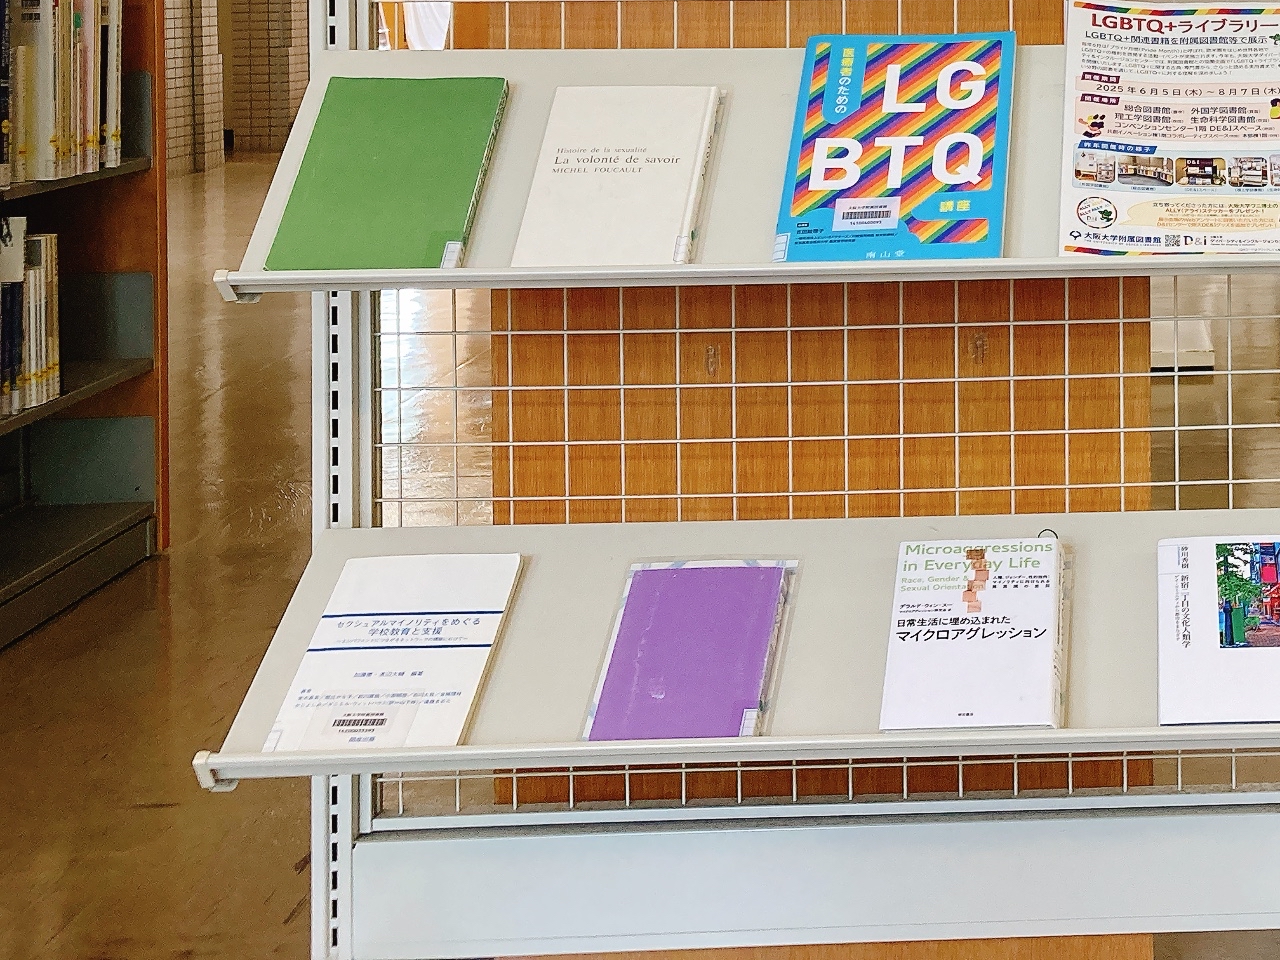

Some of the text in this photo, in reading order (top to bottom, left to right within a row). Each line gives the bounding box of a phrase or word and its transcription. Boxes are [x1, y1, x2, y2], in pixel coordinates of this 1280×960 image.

[1091, 13, 1279, 34] LGBTQ+ライブラリー
[554, 155, 681, 165] La volonté de savoir
[939, 200, 971, 213] 講座
[1084, 231, 1162, 244] 大阪大学附属図書館
[903, 557, 1041, 573] in Everyday Life
[928, 575, 961, 583] Gender
[901, 584, 930, 592] Sexual
[337, 618, 481, 629] セクシュアルマイノリティをめぐる
[897, 616, 1011, 627] 日常生活に埋め込まれた
[368, 627, 443, 636] 学校教育と支援
[896, 627, 1047, 642] マイクロアグレッション
